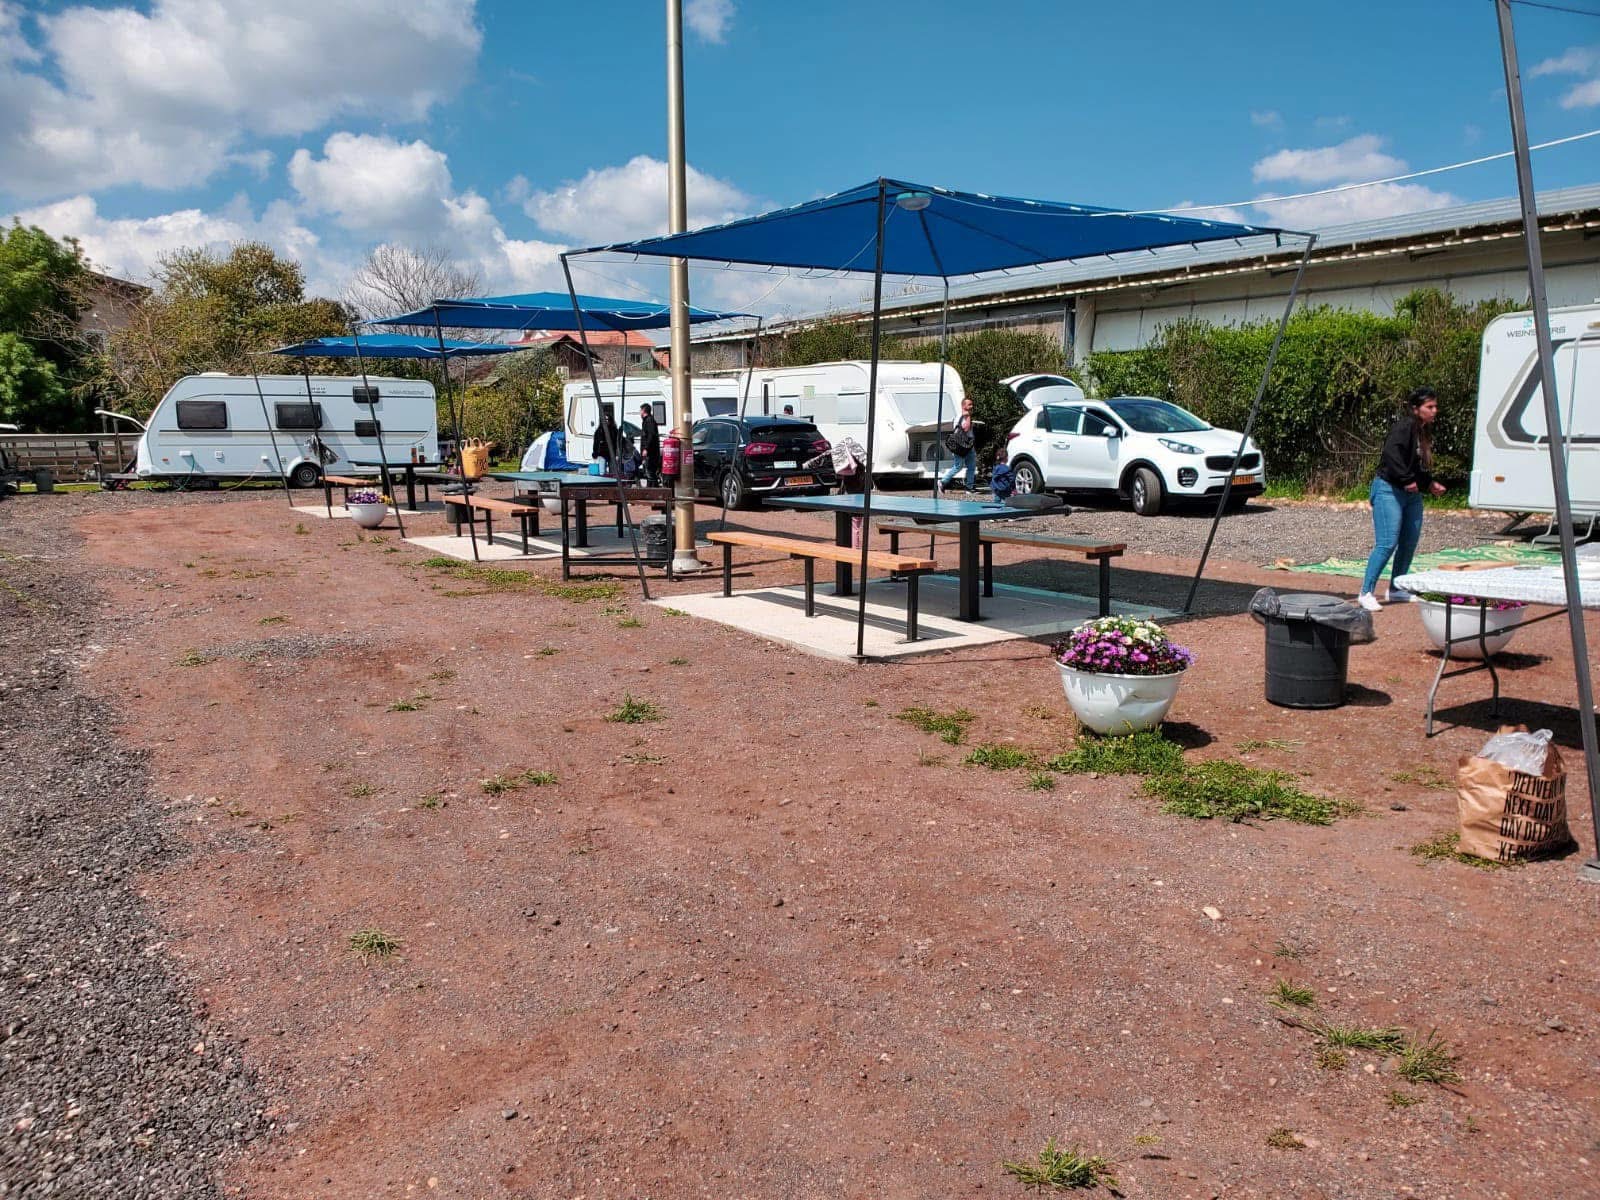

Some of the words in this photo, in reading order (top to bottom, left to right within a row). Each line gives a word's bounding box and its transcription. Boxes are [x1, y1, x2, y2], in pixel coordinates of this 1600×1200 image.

[1506, 326, 1566, 338] WEINSRG
[1504, 791, 1531, 816] NEXT
[1534, 801, 1555, 821] DAY
[1500, 817, 1522, 840] DAY
